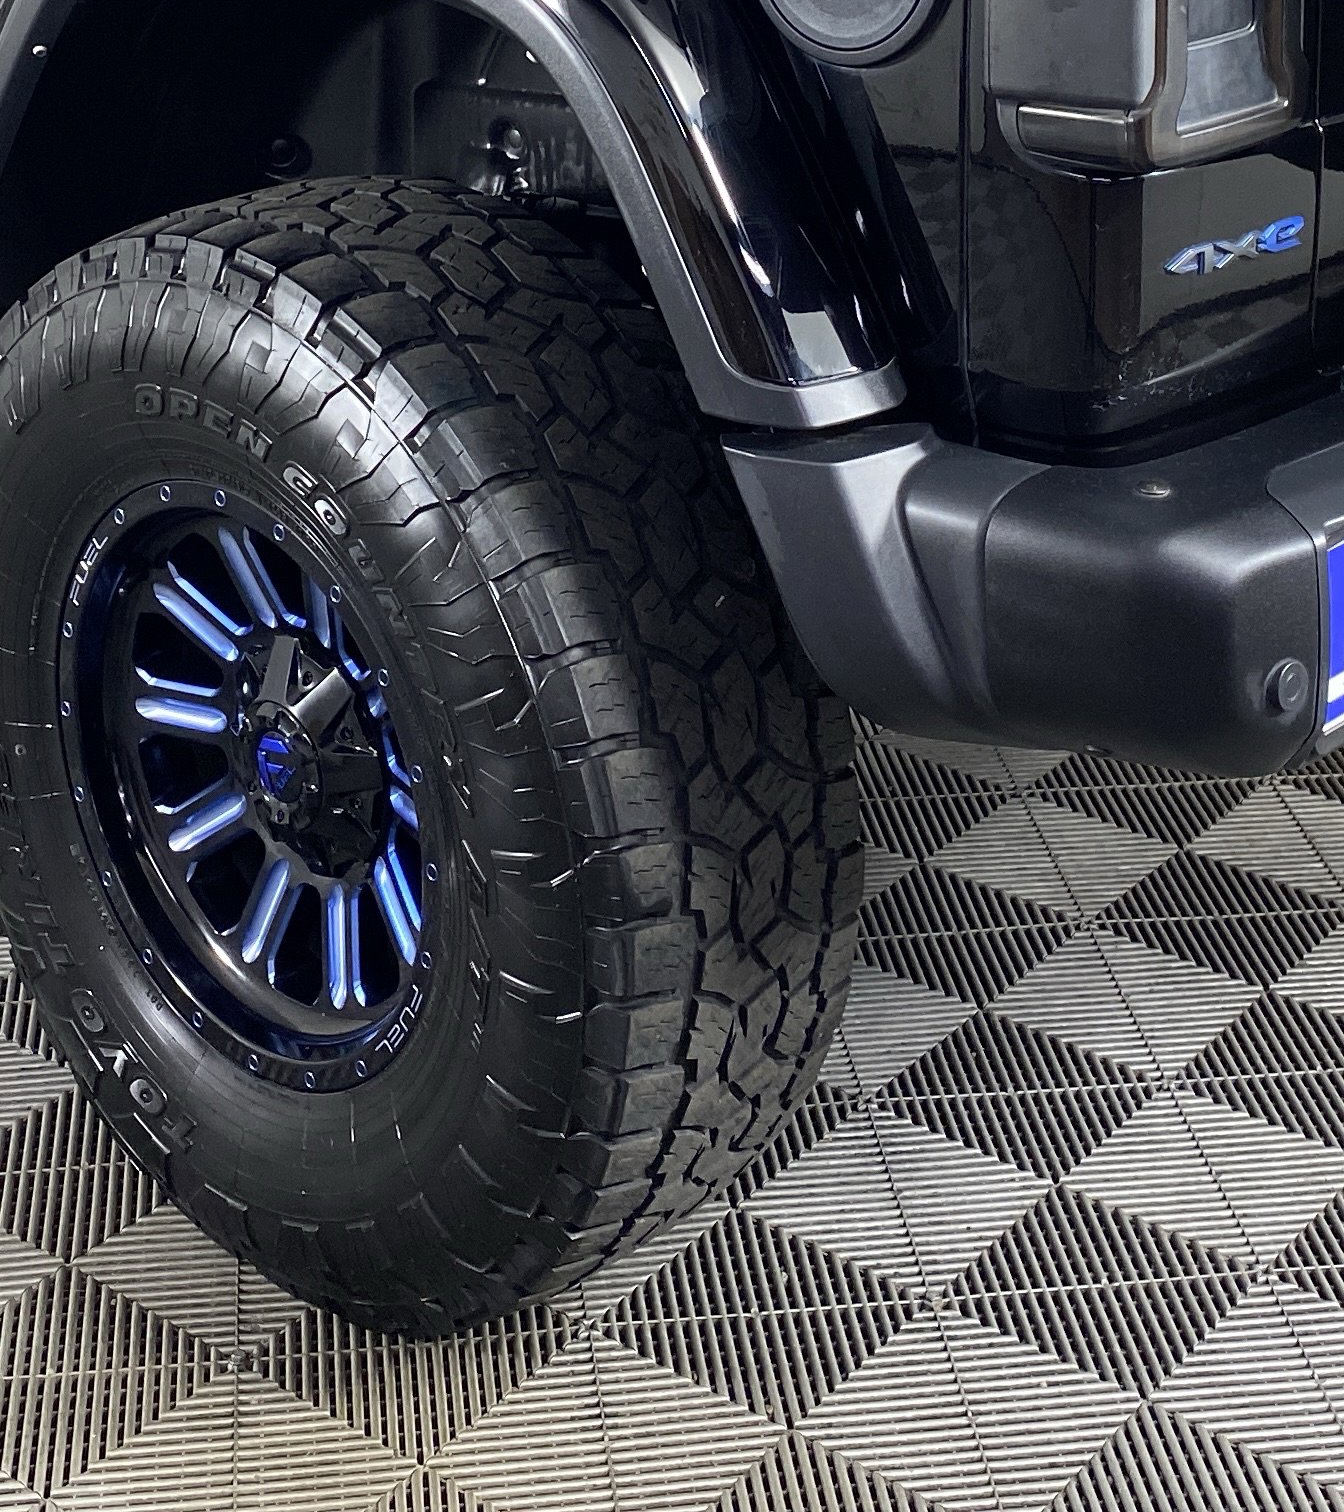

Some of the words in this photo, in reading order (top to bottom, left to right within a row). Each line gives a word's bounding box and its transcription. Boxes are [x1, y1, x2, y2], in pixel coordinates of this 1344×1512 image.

[135, 383, 273, 461] OPEN
[69, 536, 109, 606] FUEL
[374, 984, 424, 1054] FUEL
[71, 989, 198, 1151] TOYO
